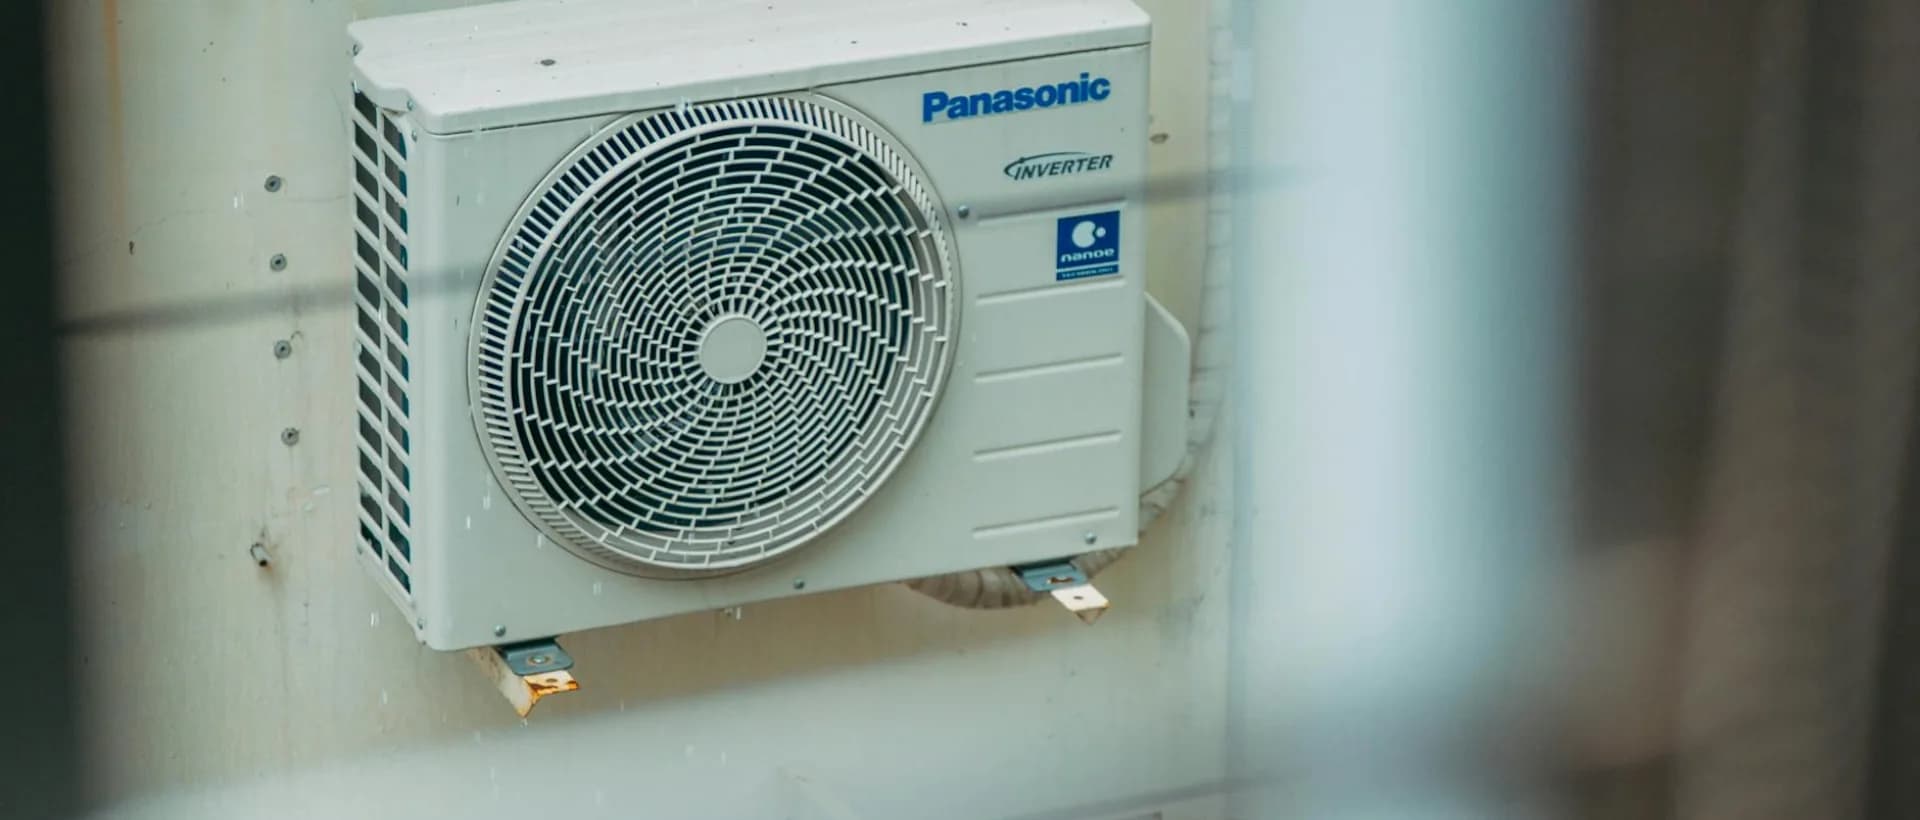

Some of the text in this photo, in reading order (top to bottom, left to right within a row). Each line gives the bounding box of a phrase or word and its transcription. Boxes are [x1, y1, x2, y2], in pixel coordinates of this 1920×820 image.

[922, 72, 1111, 123] Panasonic
[1012, 154, 1114, 180] INVERTER
[1061, 248, 1115, 263] nanoe
